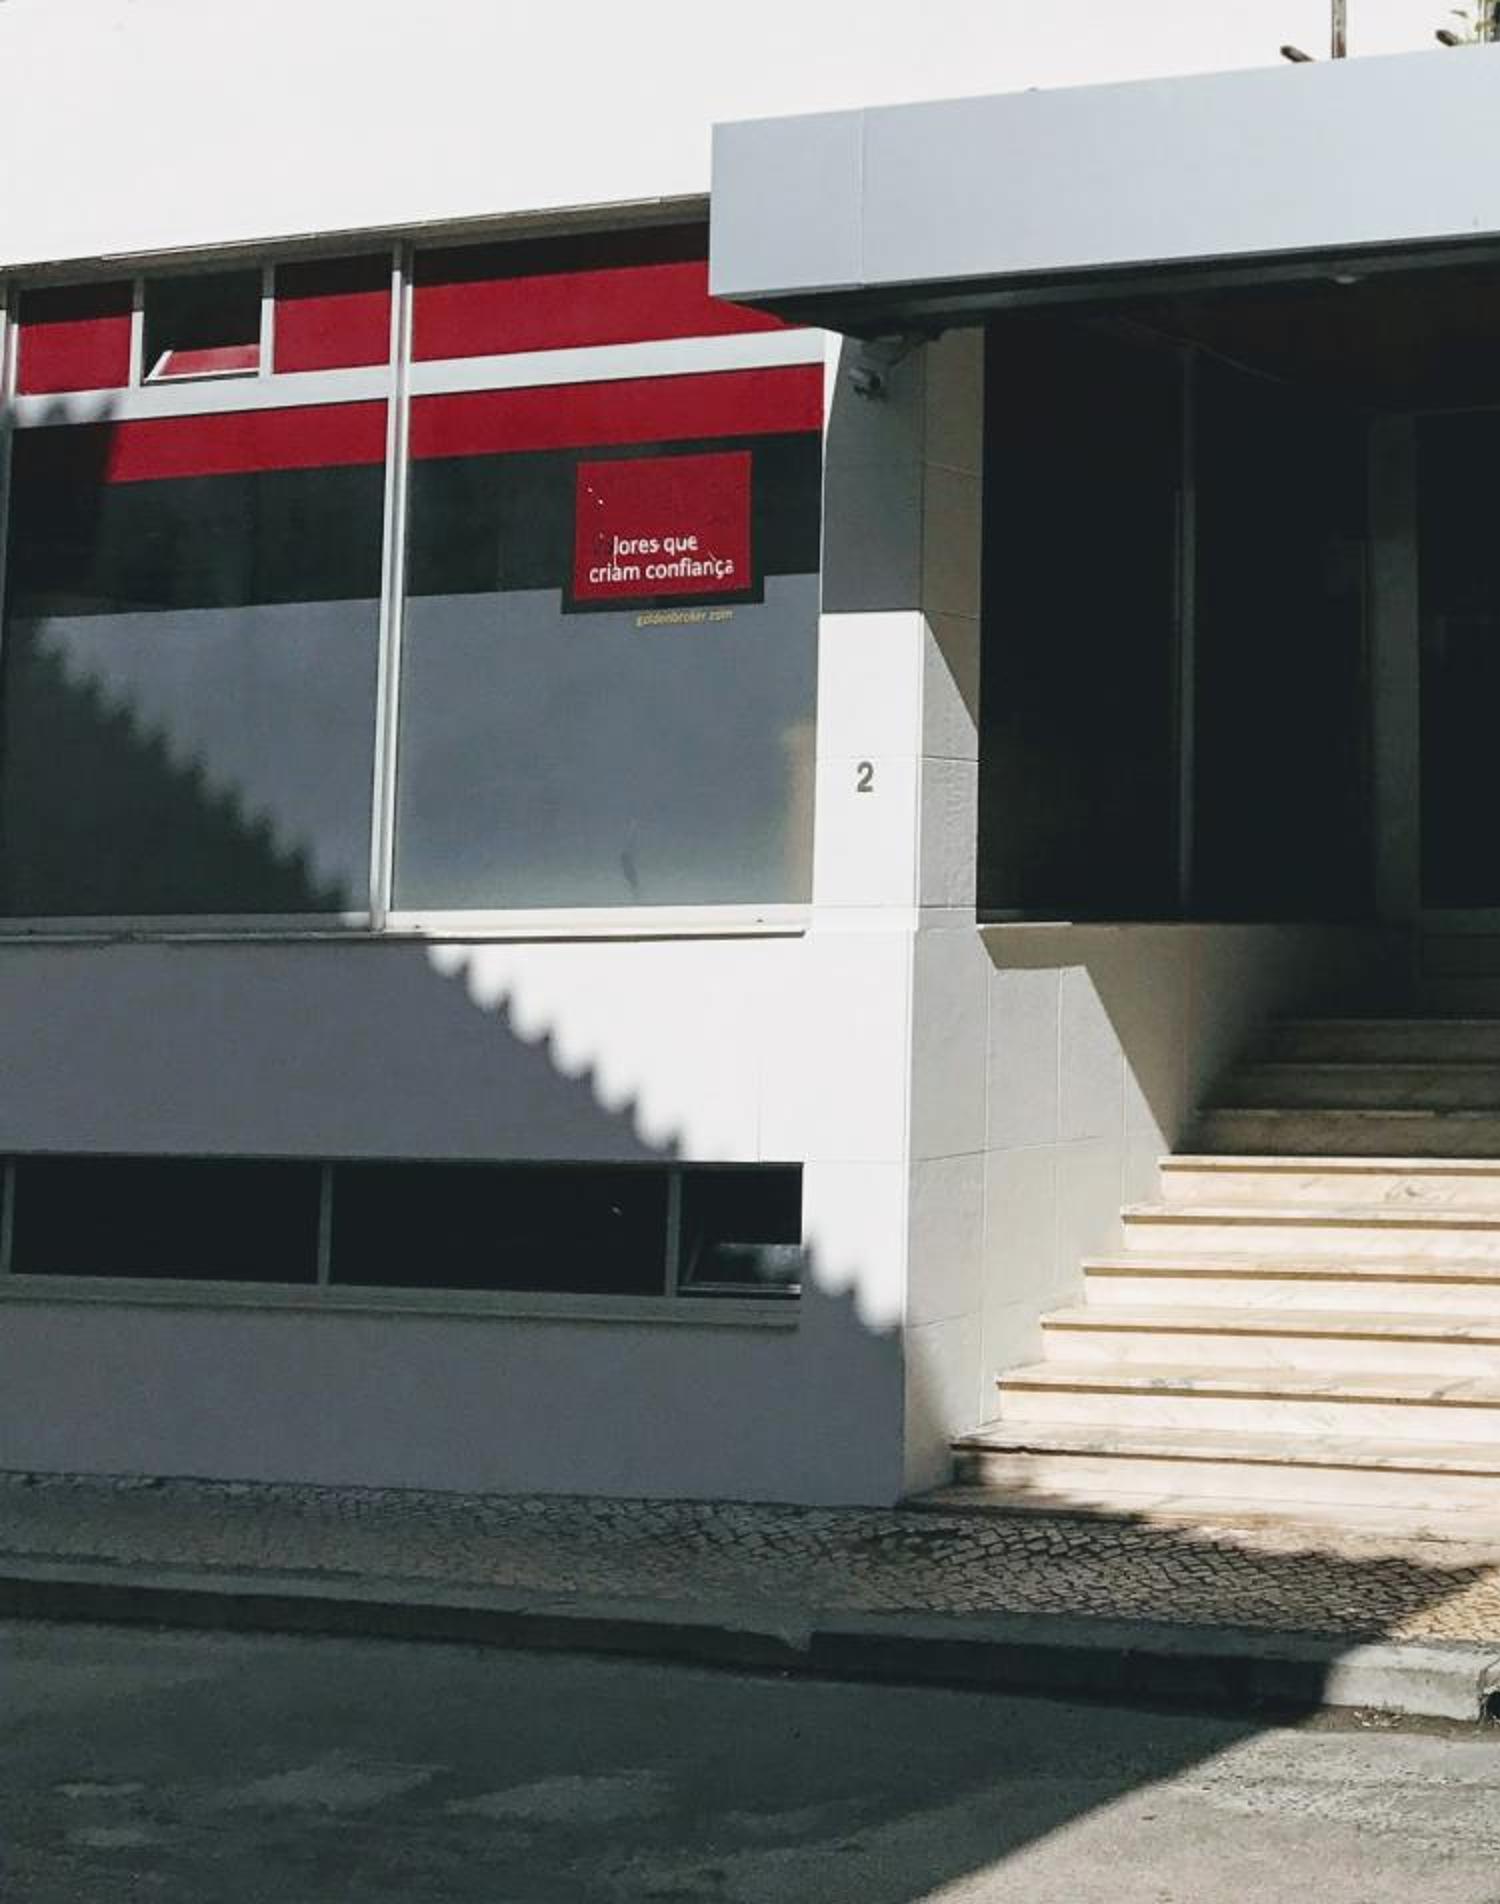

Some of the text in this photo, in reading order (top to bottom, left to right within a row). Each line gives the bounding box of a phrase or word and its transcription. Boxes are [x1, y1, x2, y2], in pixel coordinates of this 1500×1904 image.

[663, 535, 699, 556] que
[589, 557, 735, 583] criam confiança
[857, 760, 874, 793] 2
